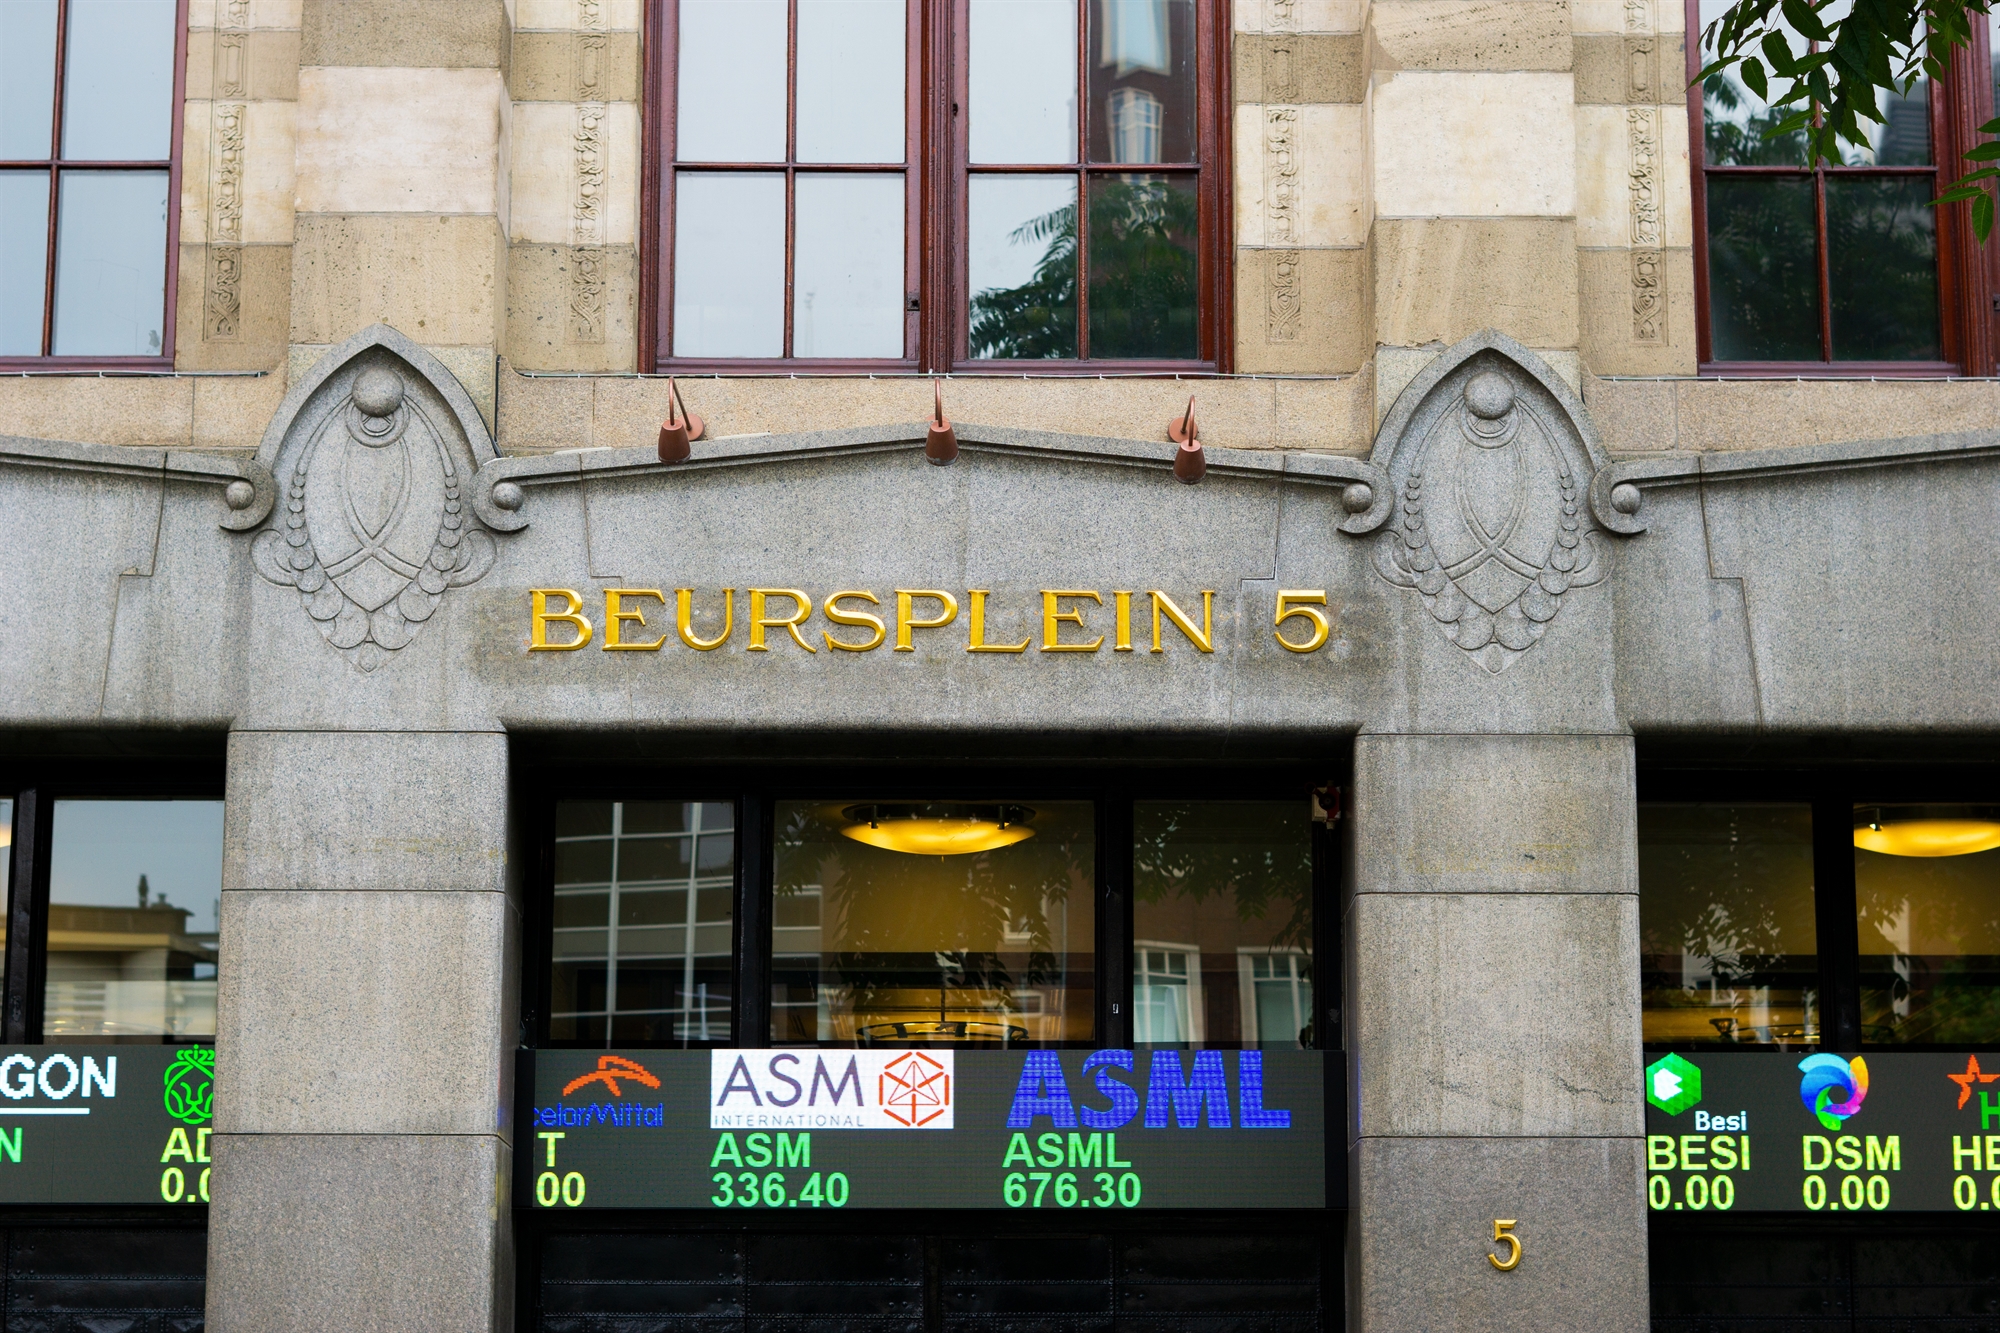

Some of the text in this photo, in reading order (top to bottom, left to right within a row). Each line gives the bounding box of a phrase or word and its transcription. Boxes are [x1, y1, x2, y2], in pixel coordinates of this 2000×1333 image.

[527, 588, 1331, 654] BEURSPLEIN 5
[715, 1053, 865, 1108] ASM
[1006, 1049, 1292, 1129] ASML
[714, 1114, 865, 1127] INTERNATIONAL
[1694, 1111, 1748, 1131] Besi
[537, 1132, 566, 1168] T
[710, 1132, 811, 1168] ASM
[1002, 1132, 1132, 1168] ASML
[1646, 1135, 1750, 1171] BESI
[1802, 1135, 1902, 1171] DSM
[536, 1171, 586, 1207] 00
[711, 1172, 850, 1208] 336.40
[1003, 1172, 1142, 1208] 676.30
[1648, 1174, 1735, 1210] 0.00
[1803, 1174, 1890, 1210] 0.00
[1488, 1218, 1522, 1272] 5
